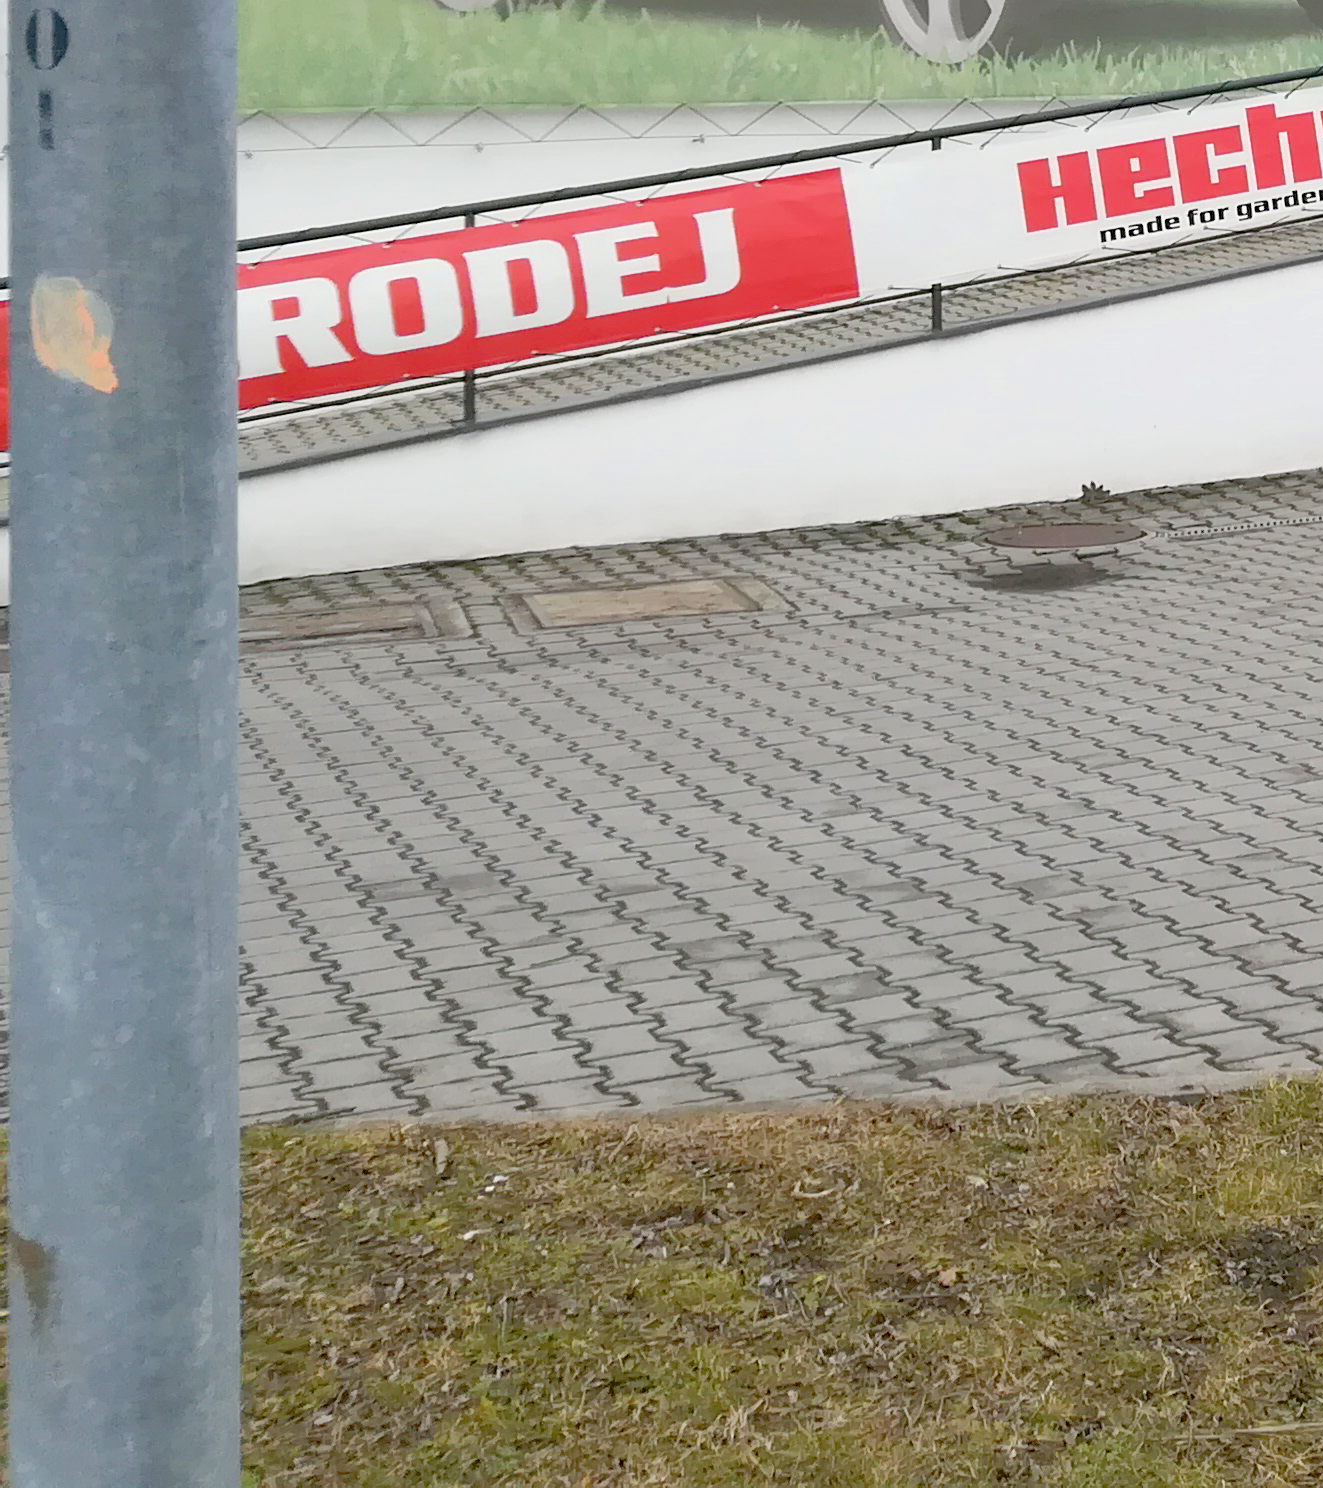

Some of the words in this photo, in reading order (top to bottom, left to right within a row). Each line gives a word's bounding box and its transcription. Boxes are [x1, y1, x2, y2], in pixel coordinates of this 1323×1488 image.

[1099, 213, 1182, 244] made
[1186, 206, 1230, 227] for
[236, 207, 743, 381] RODEJ
